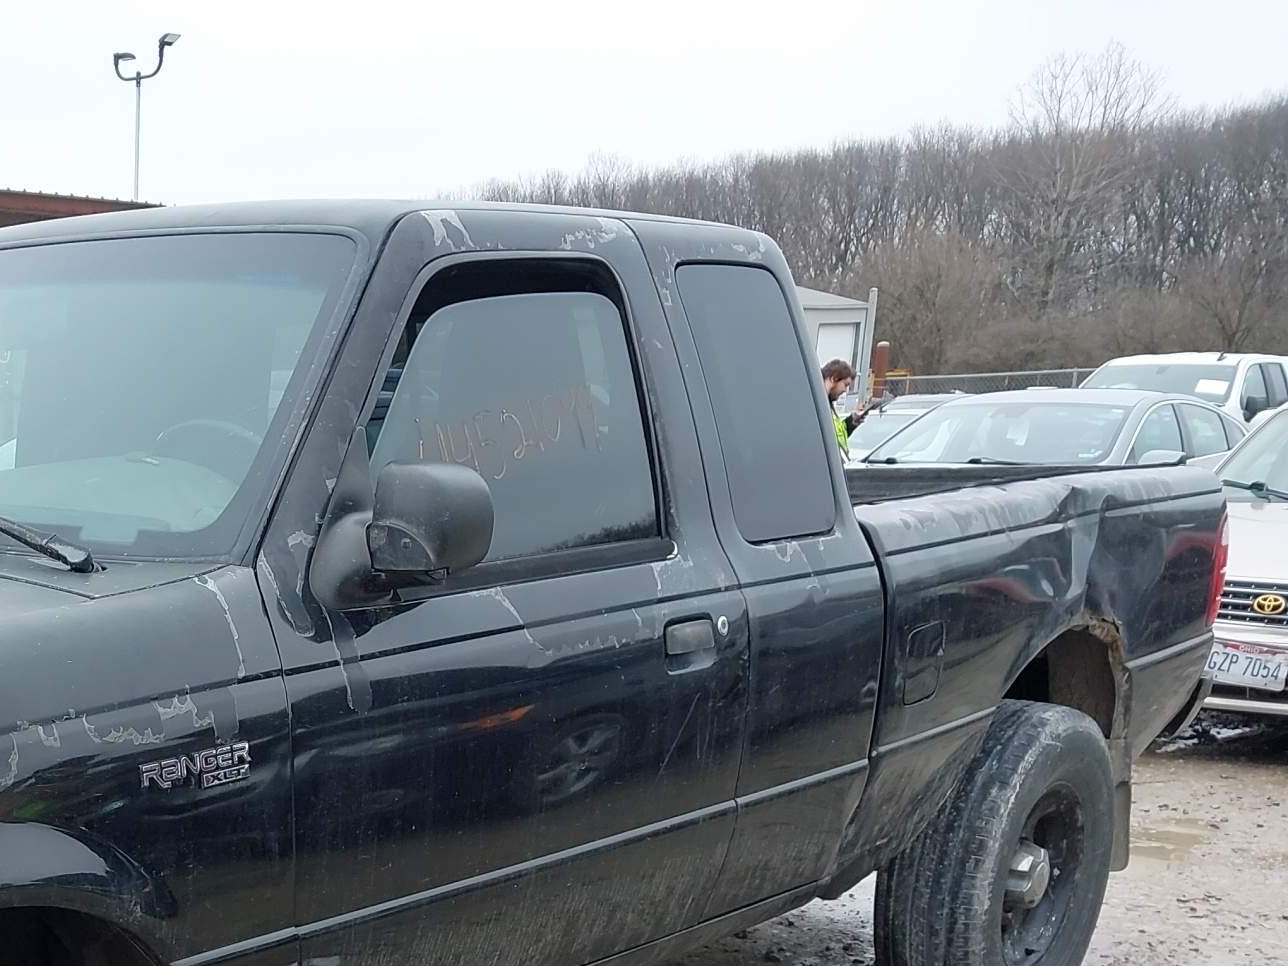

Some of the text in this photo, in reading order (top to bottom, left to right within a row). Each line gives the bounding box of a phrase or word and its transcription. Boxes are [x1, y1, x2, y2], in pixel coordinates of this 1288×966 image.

[1208, 651, 1282, 681] GZP 7054
[139, 741, 252, 790] RANGER
[202, 765, 250, 788] XLT
